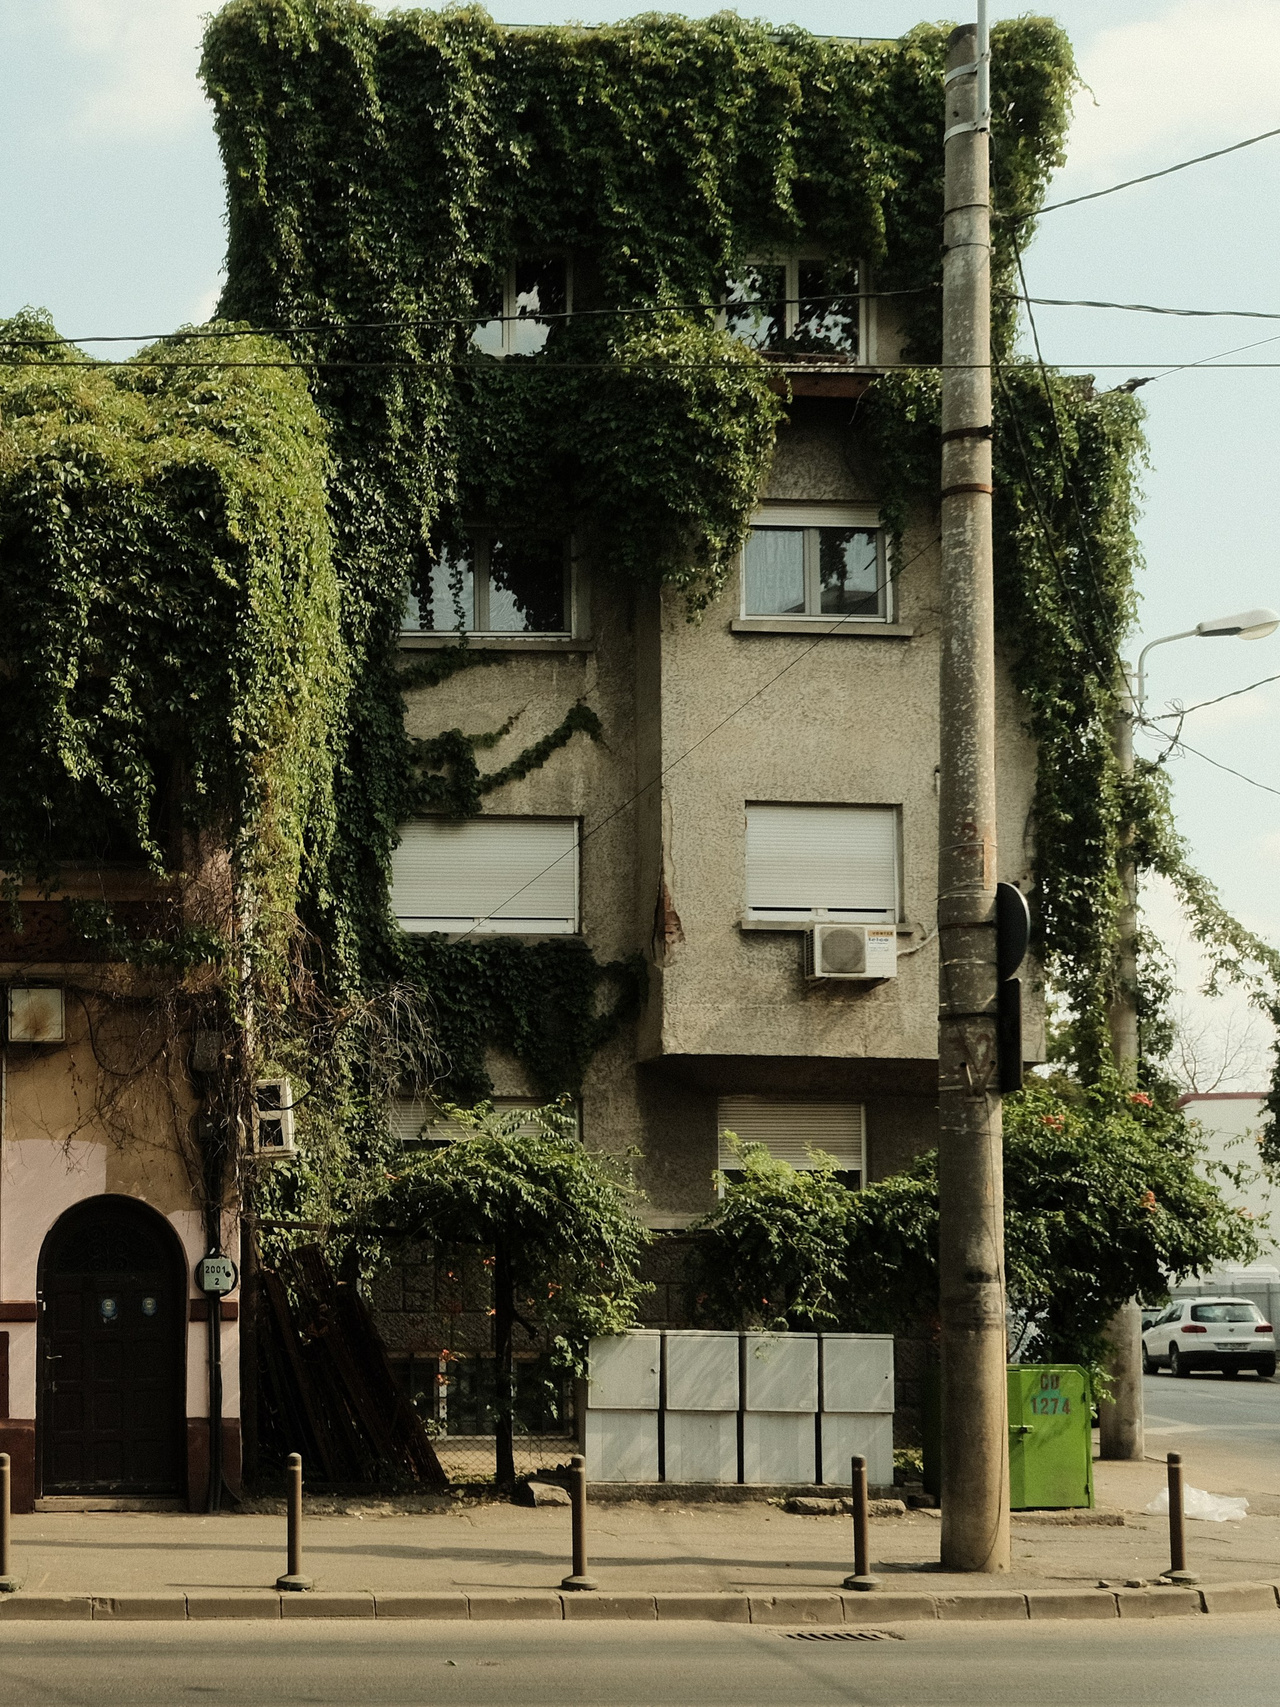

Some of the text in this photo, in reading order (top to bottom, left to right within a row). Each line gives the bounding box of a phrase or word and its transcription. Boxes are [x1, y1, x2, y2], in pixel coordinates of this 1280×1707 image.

[205, 1265, 226, 1274] 2001
[214, 1277, 220, 1286] 2
[1031, 1397, 1071, 1415] 1274
